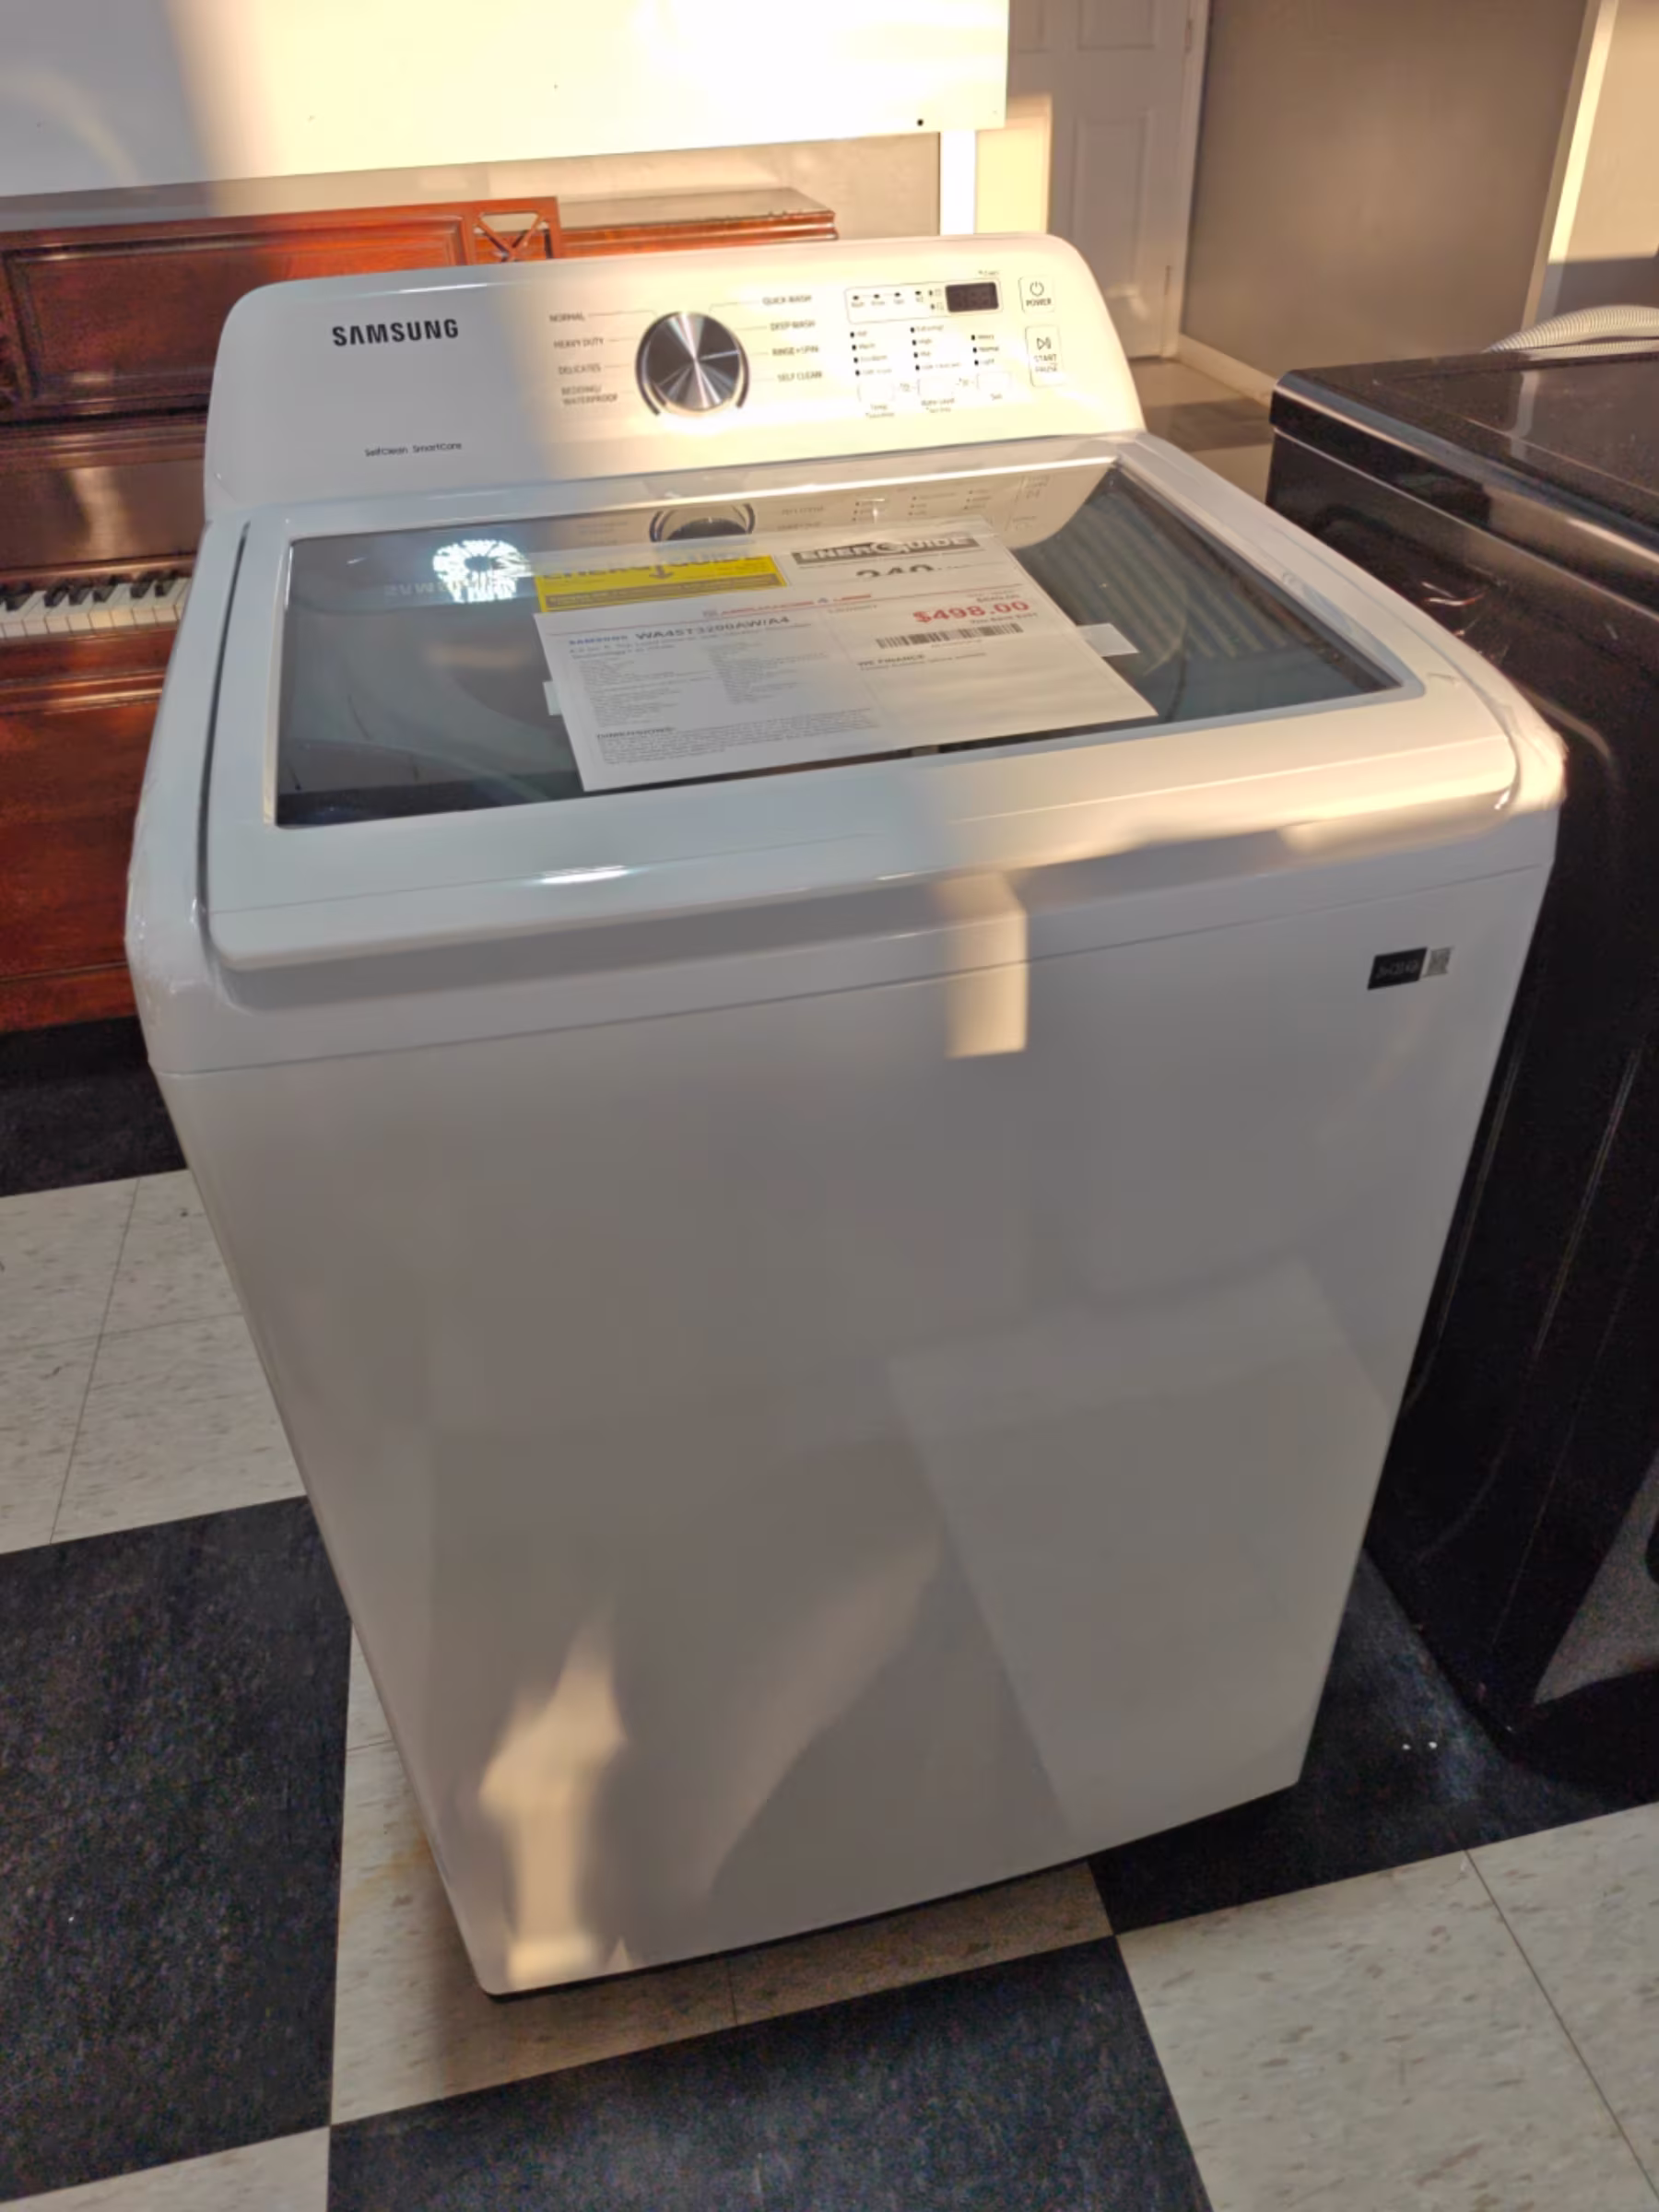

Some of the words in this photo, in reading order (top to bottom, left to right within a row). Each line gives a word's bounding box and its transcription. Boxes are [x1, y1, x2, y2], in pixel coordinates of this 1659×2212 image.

[1026, 298, 1053, 307] POWER
[549, 312, 585, 323] NORMAL
[332, 318, 459, 347] SAMSUNG
[553, 339, 582, 349] HEAVY
[583, 336, 605, 347] DUTY
[1033, 354, 1057, 363] START
[558, 363, 602, 375] DELICATES
[777, 372, 794, 382] SELF
[796, 371, 823, 382] CLEAN
[563, 394, 618, 406] WATERPROOF
[412, 442, 462, 453] SmartCare
[912, 601, 1030, 624] $498.00
